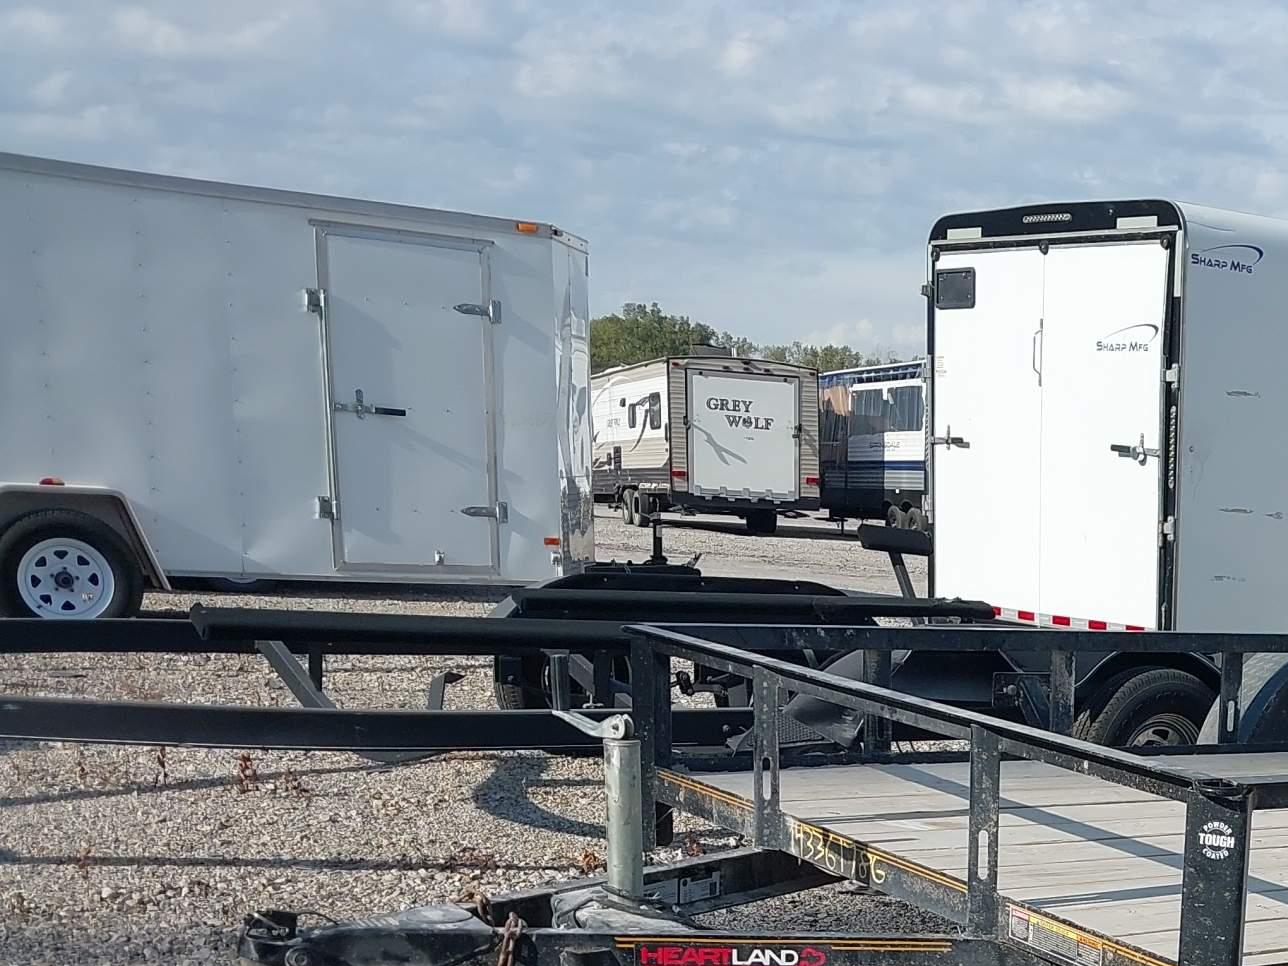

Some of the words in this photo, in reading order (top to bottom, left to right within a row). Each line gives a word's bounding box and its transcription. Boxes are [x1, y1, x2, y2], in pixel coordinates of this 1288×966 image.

[706, 397, 753, 412] GREY
[725, 414, 775, 431] WOLF
[1203, 821, 1233, 836] POWDER
[1198, 832, 1235, 849] TOUGH
[1202, 848, 1229, 860] COATED
[640, 946, 799, 966] HEARTLAND
